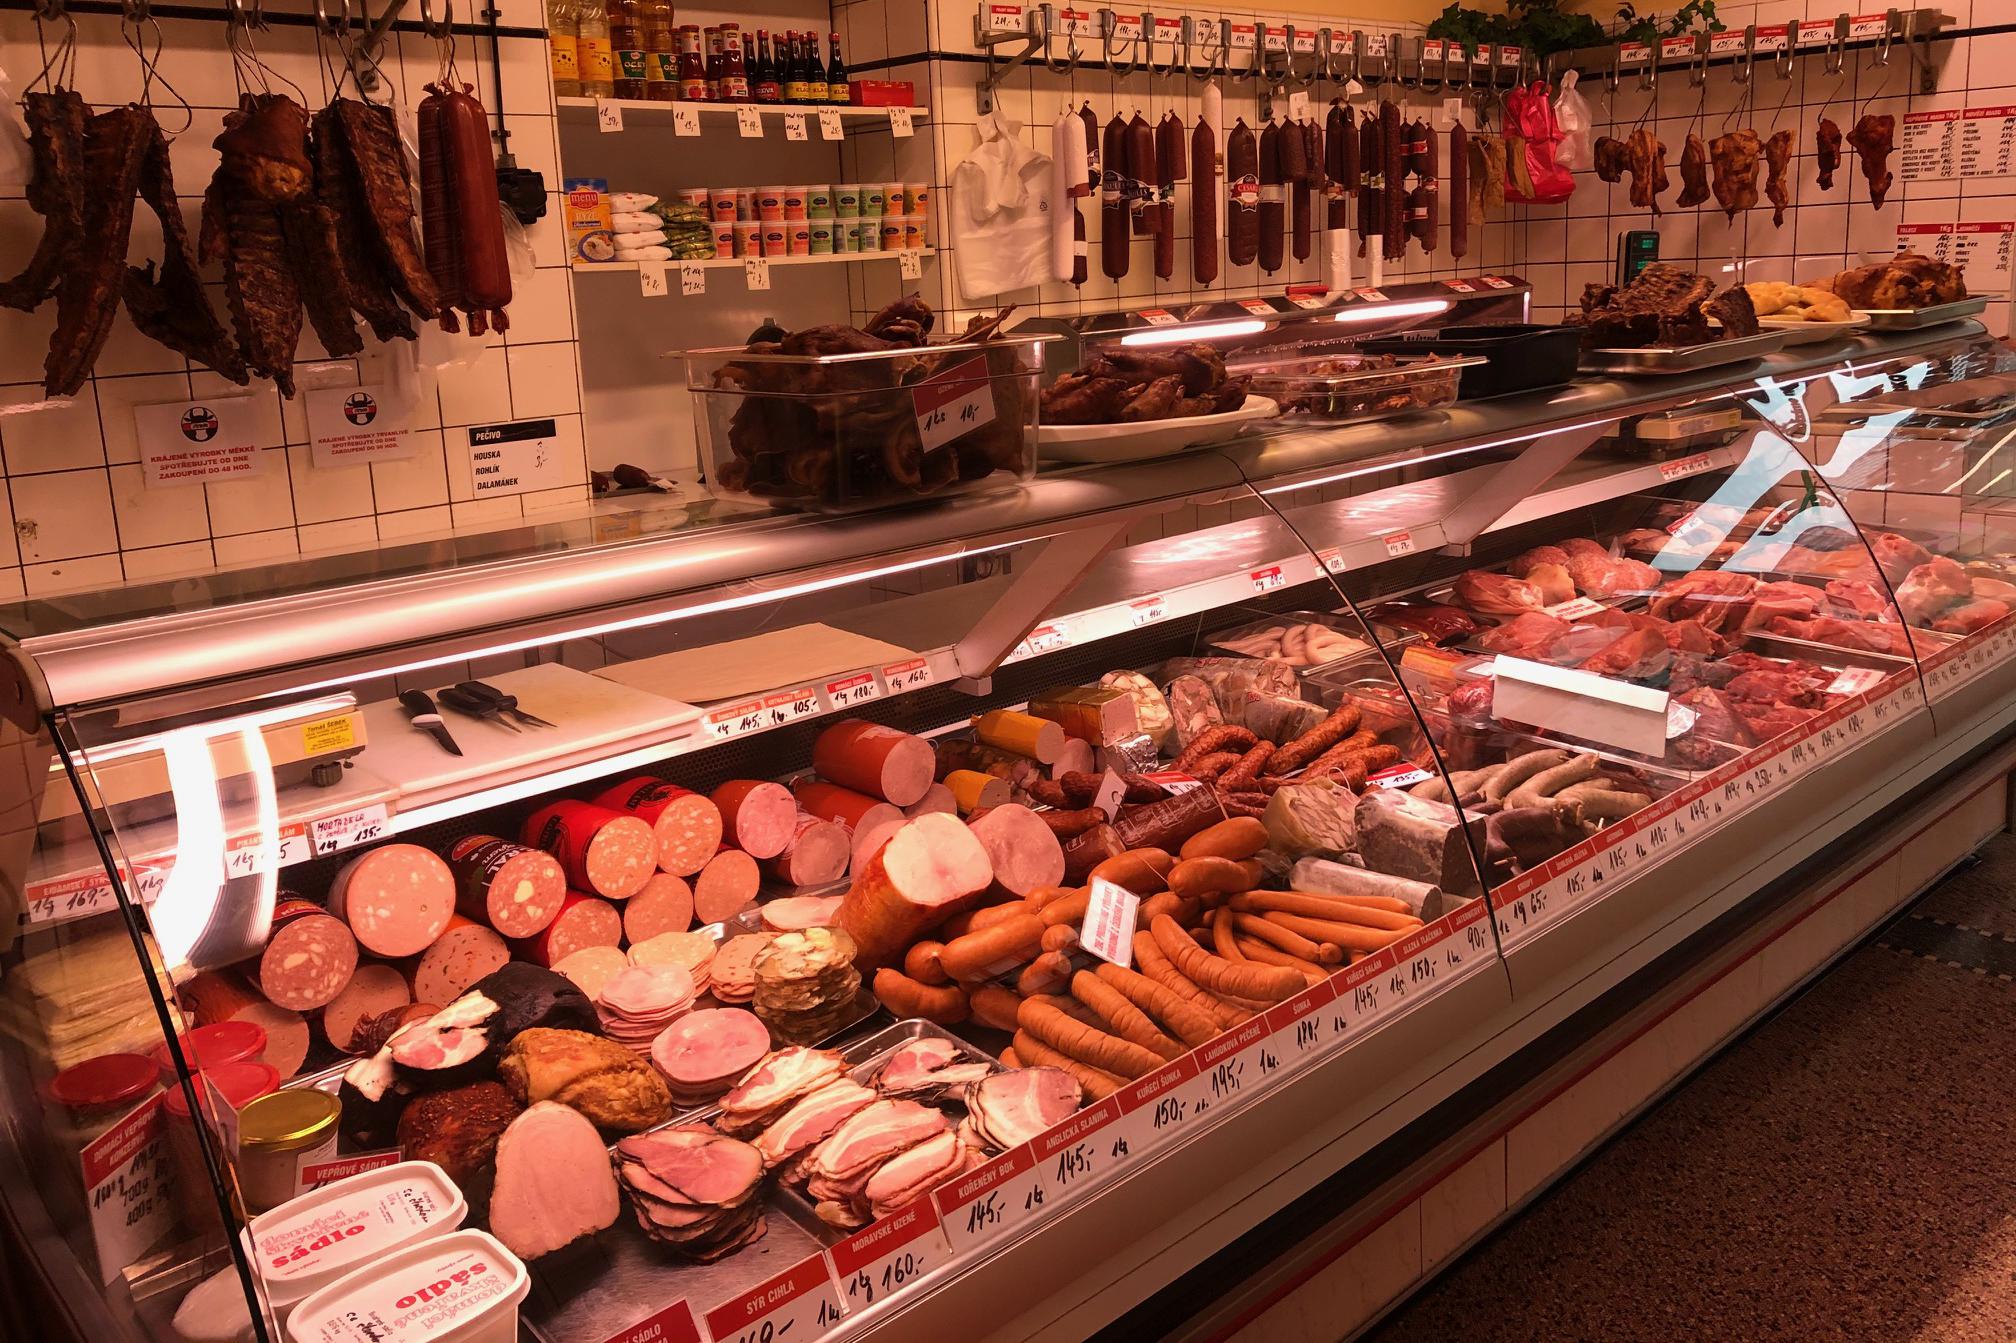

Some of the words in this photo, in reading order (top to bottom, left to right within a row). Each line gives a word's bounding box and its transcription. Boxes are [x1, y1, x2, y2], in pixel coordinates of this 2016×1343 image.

[318, 436, 346, 444] KRÁJENÉ
[347, 432, 375, 441] VÝROBKY
[376, 429, 409, 438] TRVANLIVÉ
[331, 439, 374, 449] SPOTŘEBUJTE
[475, 430, 501, 441] PEČIVO
[150, 452, 188, 463] KRÁJENÉ
[189, 447, 227, 459] VÝROBKY
[228, 445, 256, 455] MĚKKÉ
[331, 445, 366, 456] ZAKOUPENÍ
[473, 450, 501, 461] HOUSKA
[159, 458, 218, 471] SPOTŘEBUJTE
[220, 457, 231, 465] OD
[232, 455, 249, 463] DNE
[159, 466, 207, 480] ZAKOUPENÍ
[208, 467, 220, 475] DO
[221, 465, 231, 473] 48
[232, 463, 252, 472] HOD.
[475, 463, 500, 475] ROHLÍK
[477, 476, 519, 490] DALAMÁNEK
[853, 684, 874, 699] 180,-
[793, 698, 818, 715] 105,-
[739, 713, 762, 731] 145,-
[232, 851, 254, 872] 1kg
[1411, 956, 1437, 985] 150,-
[1292, 999, 1312, 1016] ŠUNKA
[1354, 983, 1379, 1015] 145,-
[1136, 1079, 1160, 1101] KUŘECÍ
[1160, 1068, 1182, 1088] ŠUNKA
[1212, 1056, 1244, 1098] 195,-
[1153, 1096, 1187, 1130] 150,-
[1046, 1122, 1080, 1151] ANGLICKÁ
[1080, 1110, 1109, 1131] SLANINA
[316, 1163, 356, 1180] VEPŘOVÉ
[999, 1159, 1016, 1176] BOK
[1056, 1143, 1095, 1185] 145,-
[966, 1190, 1006, 1234] 145,-
[851, 1222, 893, 1254] MORAVSKÉ
[893, 1210, 918, 1232] UZENÉ
[271, 1224, 366, 1269] sádlo
[394, 1262, 488, 1309] sádlo
[848, 1269, 874, 1303] 1kg
[881, 1252, 925, 1292] 160,-
[746, 1294, 766, 1316] SÝR
[767, 1278, 796, 1304] CIHLA
[631, 1323, 661, 1343] SÁDLO
